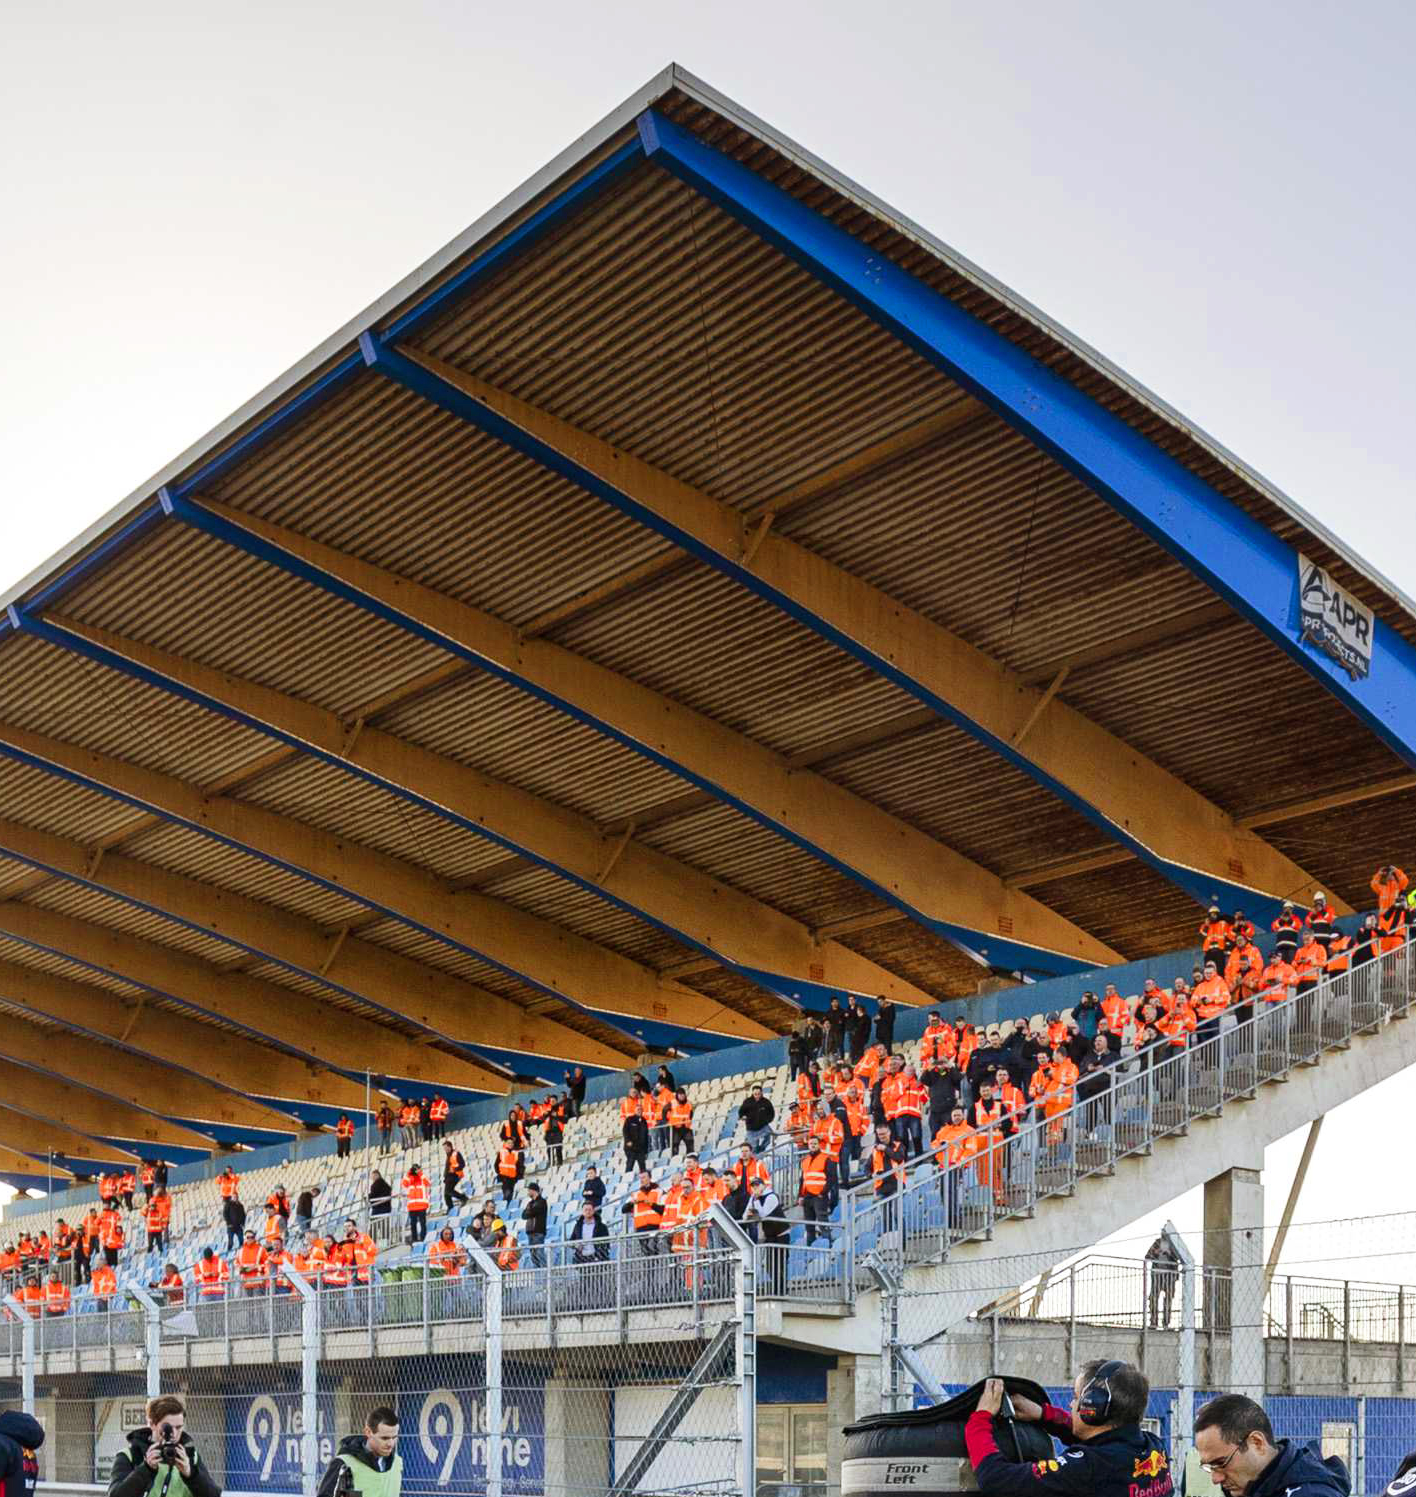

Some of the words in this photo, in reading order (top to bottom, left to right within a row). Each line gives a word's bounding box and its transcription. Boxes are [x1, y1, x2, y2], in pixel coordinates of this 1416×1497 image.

[1329, 592, 1369, 645] APR
[286, 1405, 323, 1435] lei
[471, 1437, 531, 1467] nne
[885, 1475, 916, 1484] Left
[887, 1463, 929, 1474] Front
